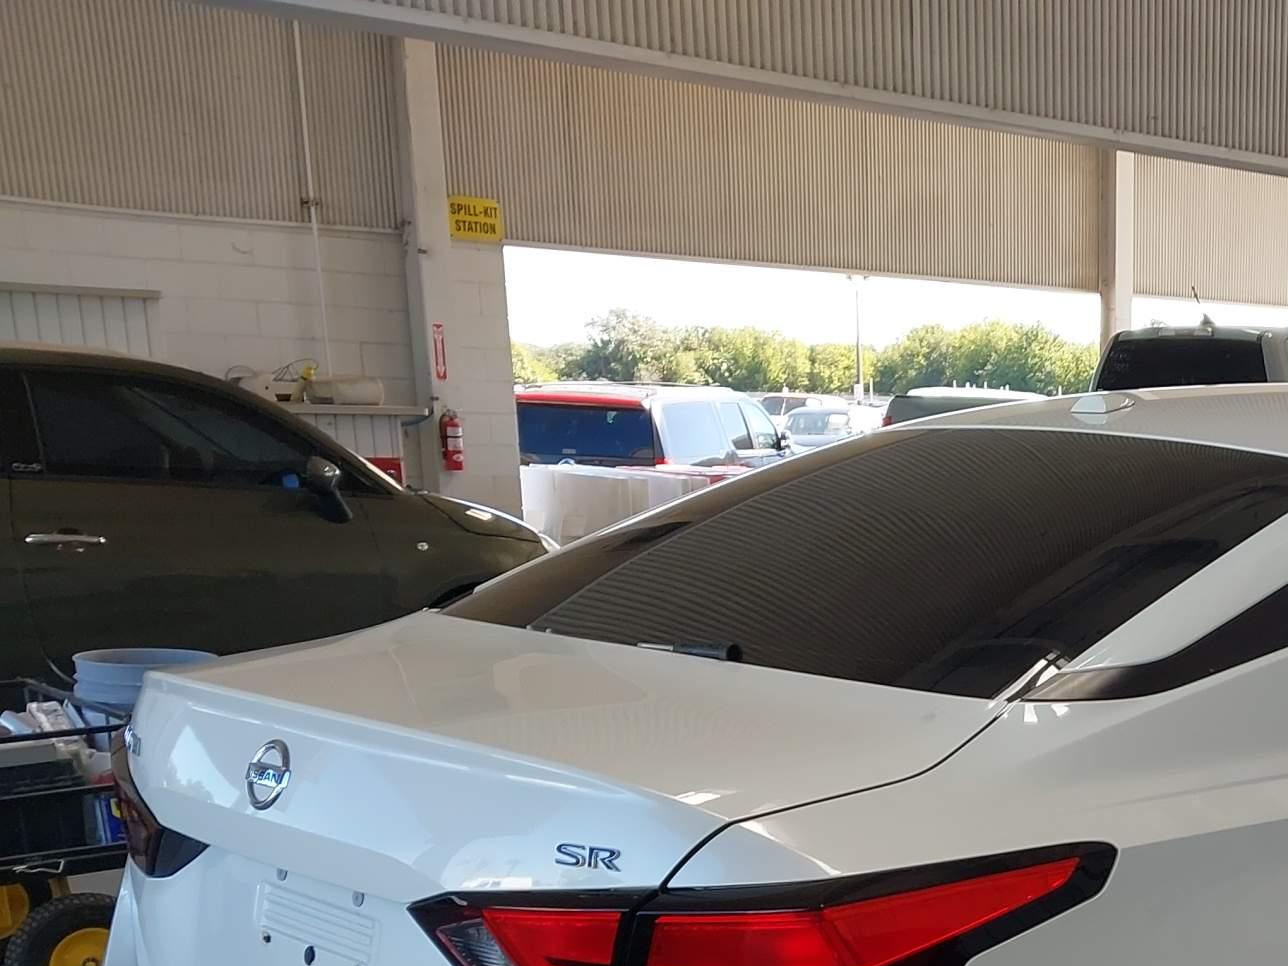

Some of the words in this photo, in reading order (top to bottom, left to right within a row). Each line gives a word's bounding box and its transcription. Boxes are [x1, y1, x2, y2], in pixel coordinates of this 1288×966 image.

[450, 203, 497, 219] SPILL-KIT
[455, 220, 497, 235] STATION
[249, 767, 284, 785] SSAN
[554, 843, 622, 872] SR
